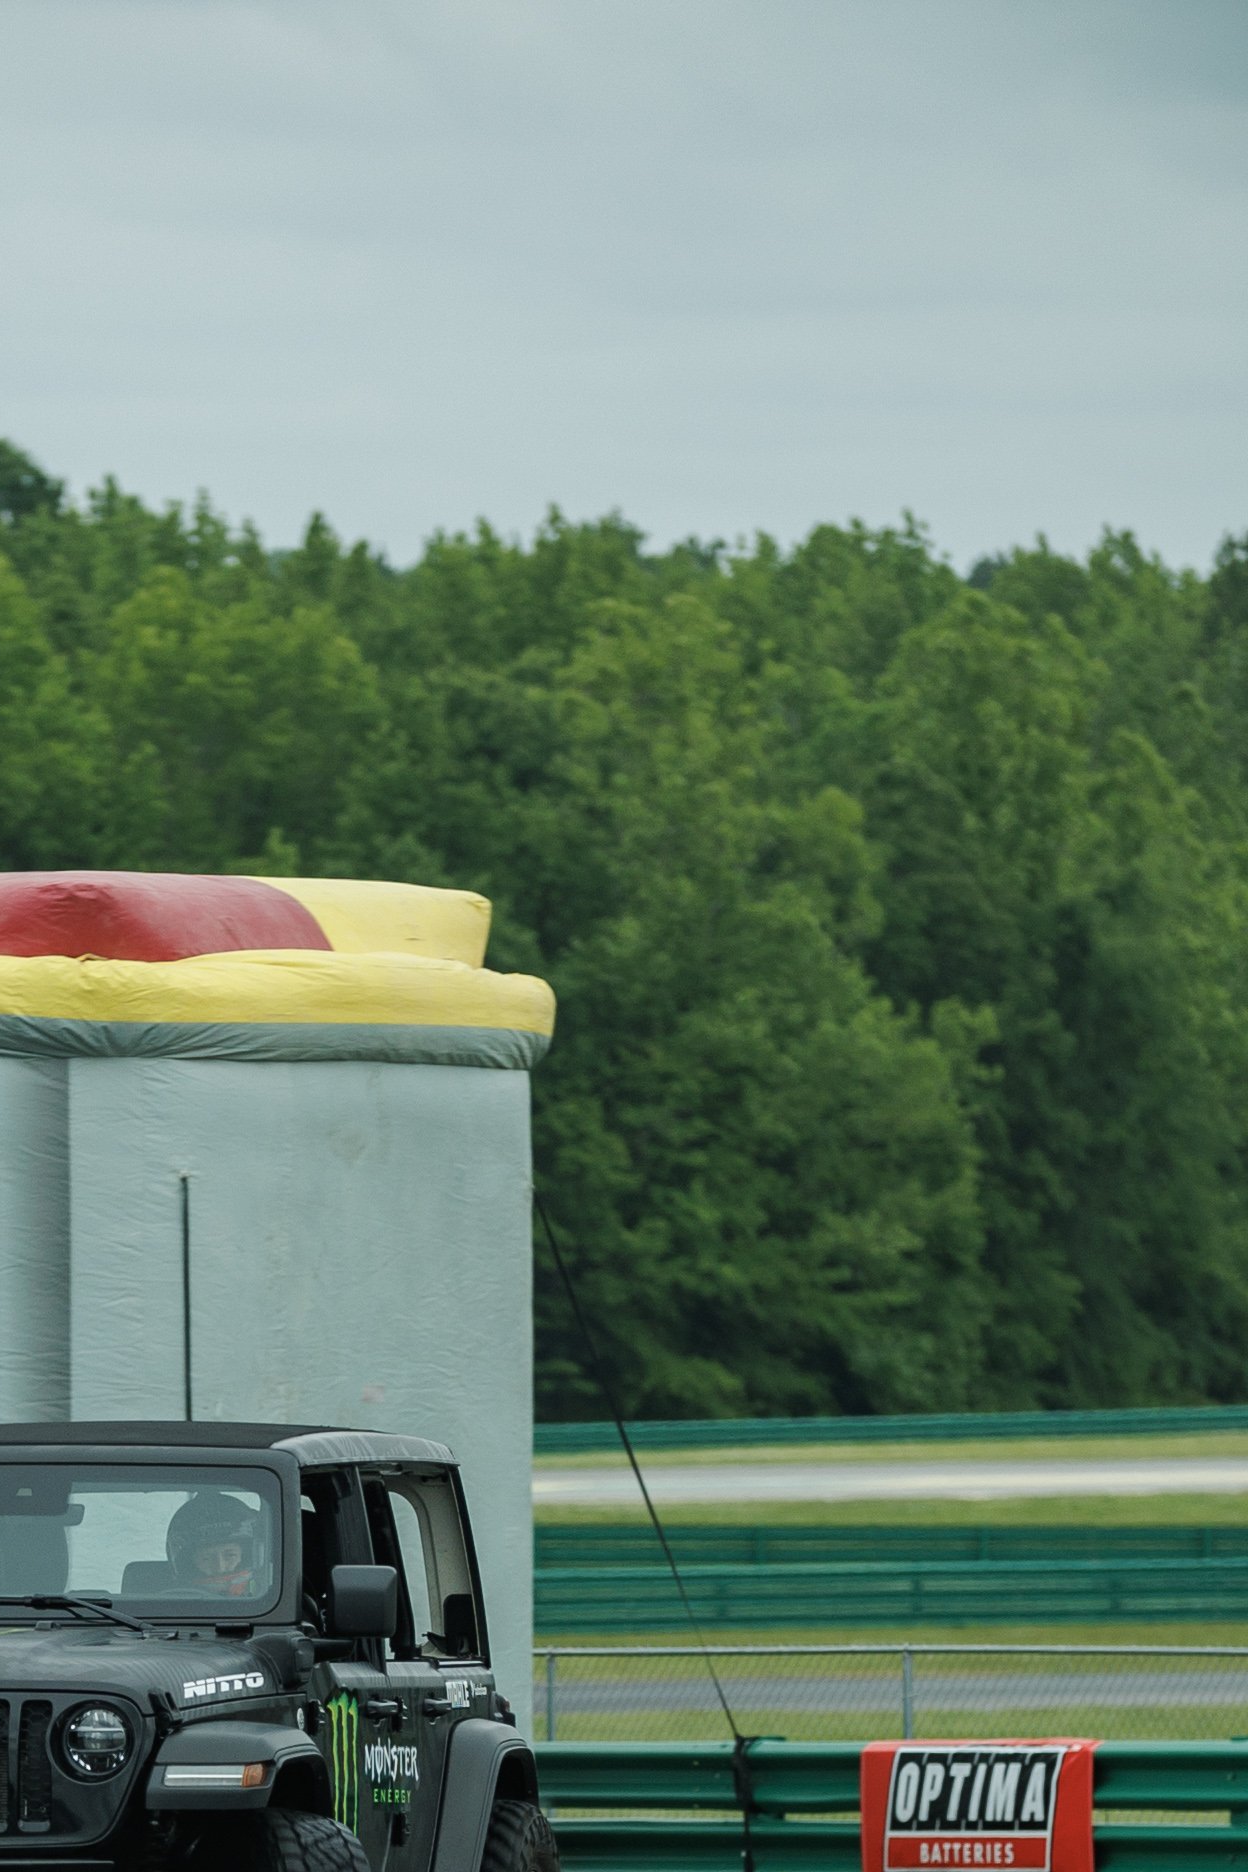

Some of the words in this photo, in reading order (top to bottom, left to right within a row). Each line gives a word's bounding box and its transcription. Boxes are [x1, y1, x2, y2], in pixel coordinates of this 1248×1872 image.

[183, 1671, 264, 1699] NITTO
[364, 1737, 419, 1784] MONSTER
[374, 1788, 412, 1803] ENERGY
[895, 1761, 1047, 1823] OPTIMA
[919, 1842, 1015, 1865] BATTERIES
